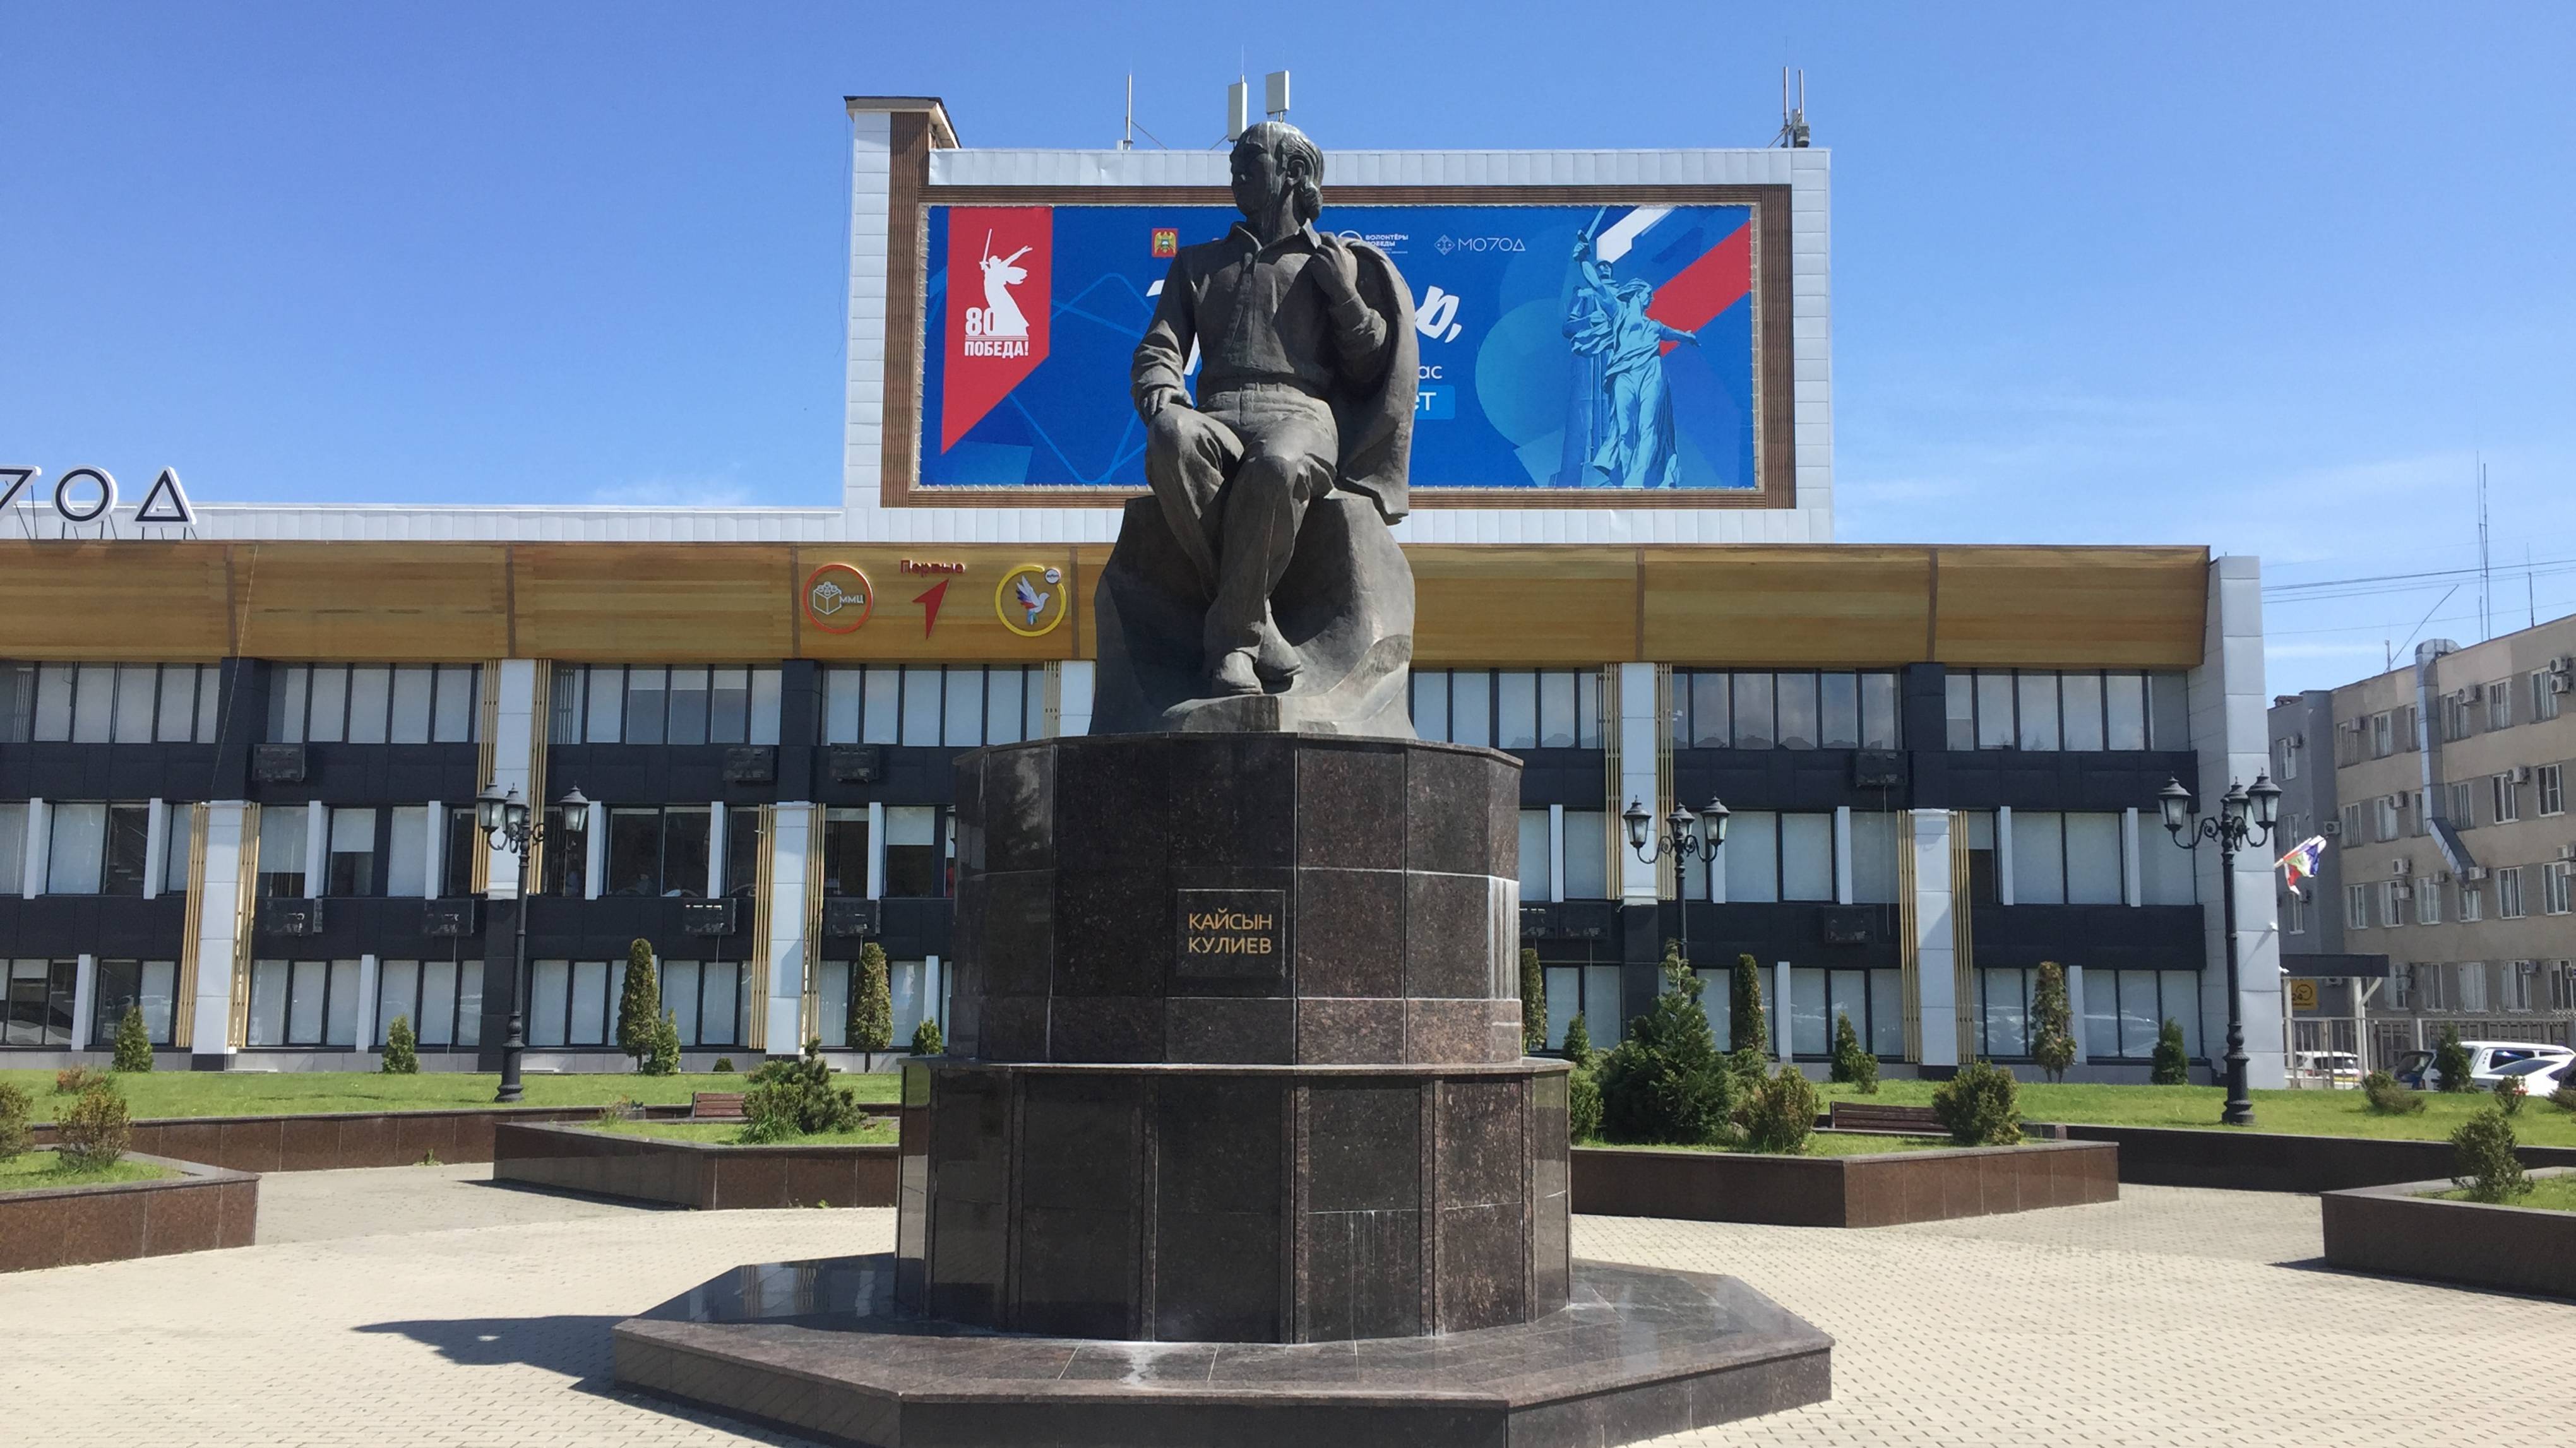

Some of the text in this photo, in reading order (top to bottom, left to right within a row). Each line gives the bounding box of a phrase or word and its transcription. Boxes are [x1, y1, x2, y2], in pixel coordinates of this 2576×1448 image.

[965, 307, 995, 336] 80
[964, 341, 1030, 359] ПОБЕДА!
[839, 595, 864, 604] ММЦ
[1189, 908, 1272, 930] КАЙСЫН
[1188, 937, 1272, 954] КУЛИЕВ
